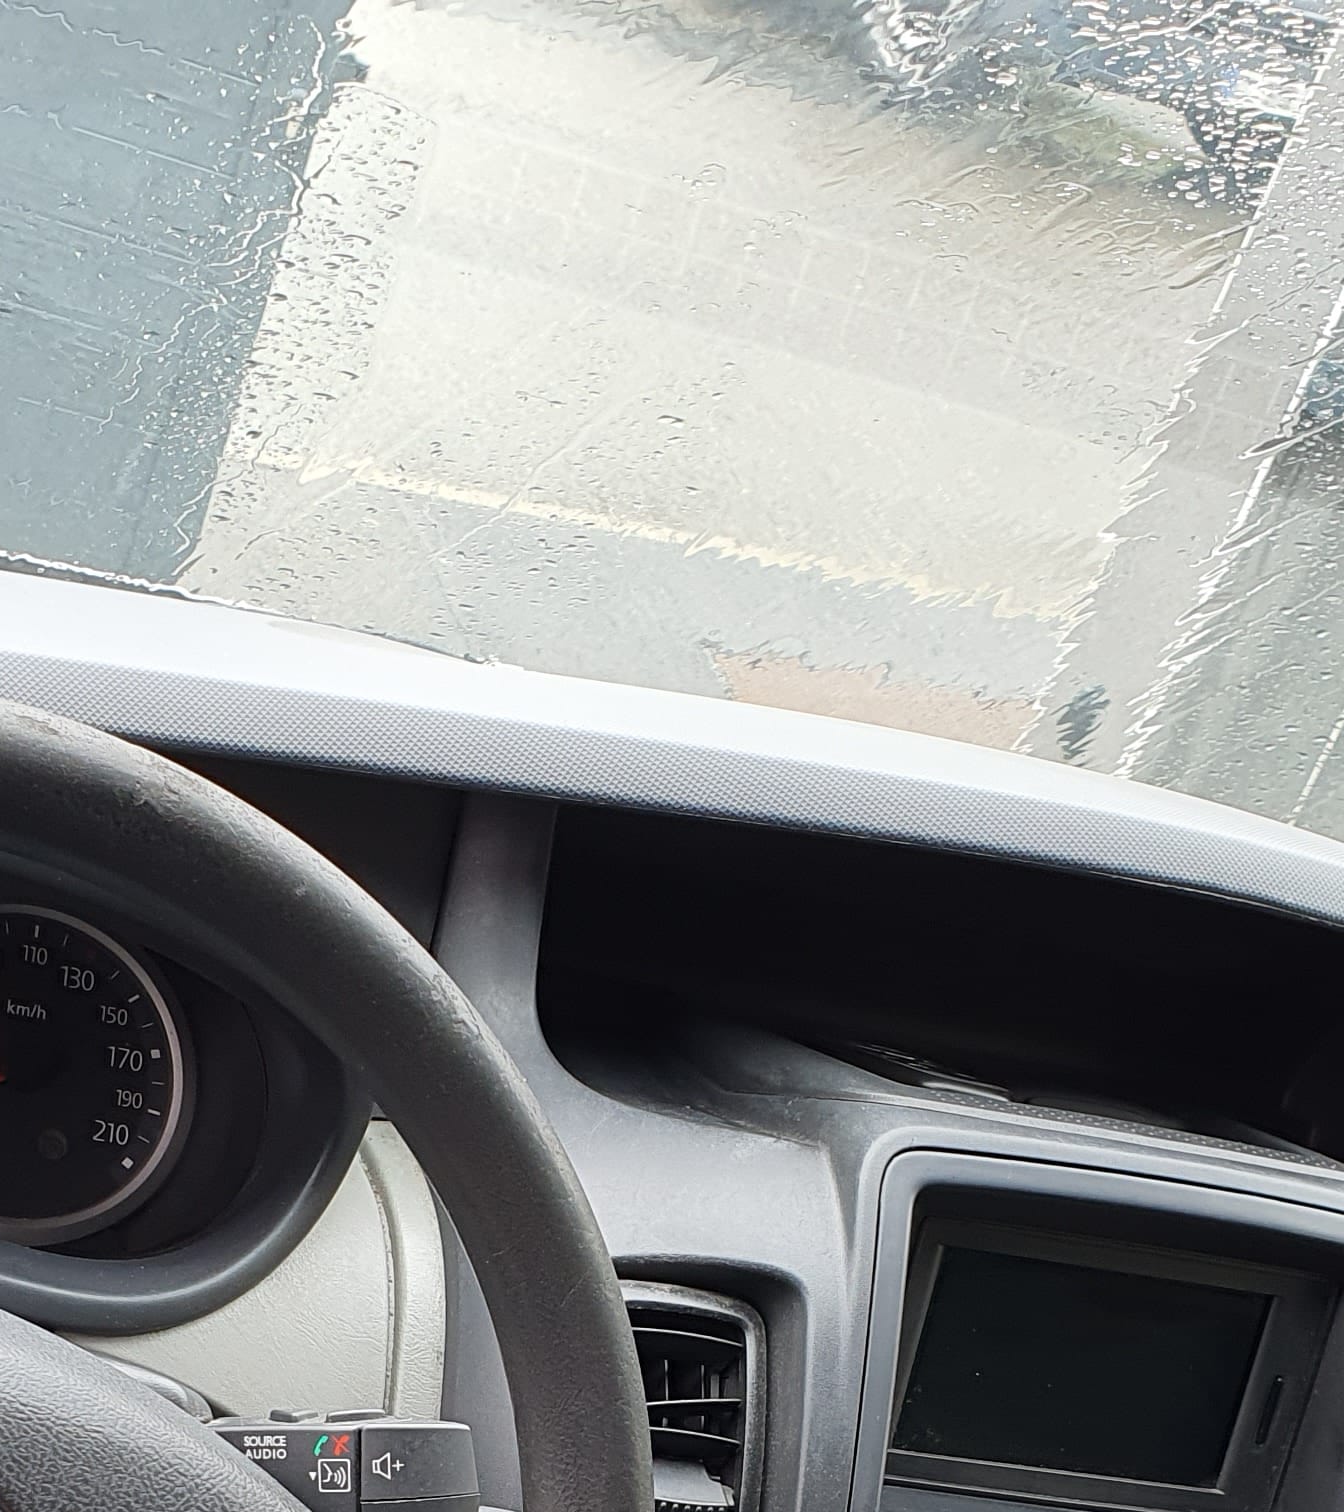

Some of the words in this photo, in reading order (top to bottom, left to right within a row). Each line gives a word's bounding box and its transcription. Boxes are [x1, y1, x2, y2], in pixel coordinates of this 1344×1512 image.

[22, 944, 49, 965] 110
[60, 966, 96, 992] 130
[6, 999, 48, 1021] km/h
[99, 1005, 129, 1026] 150
[106, 1046, 144, 1072] 170
[115, 1089, 144, 1109] 190
[91, 1119, 130, 1145] 210
[243, 1434, 287, 1447] SOURCE
[244, 1448, 287, 1460] AUDIO
